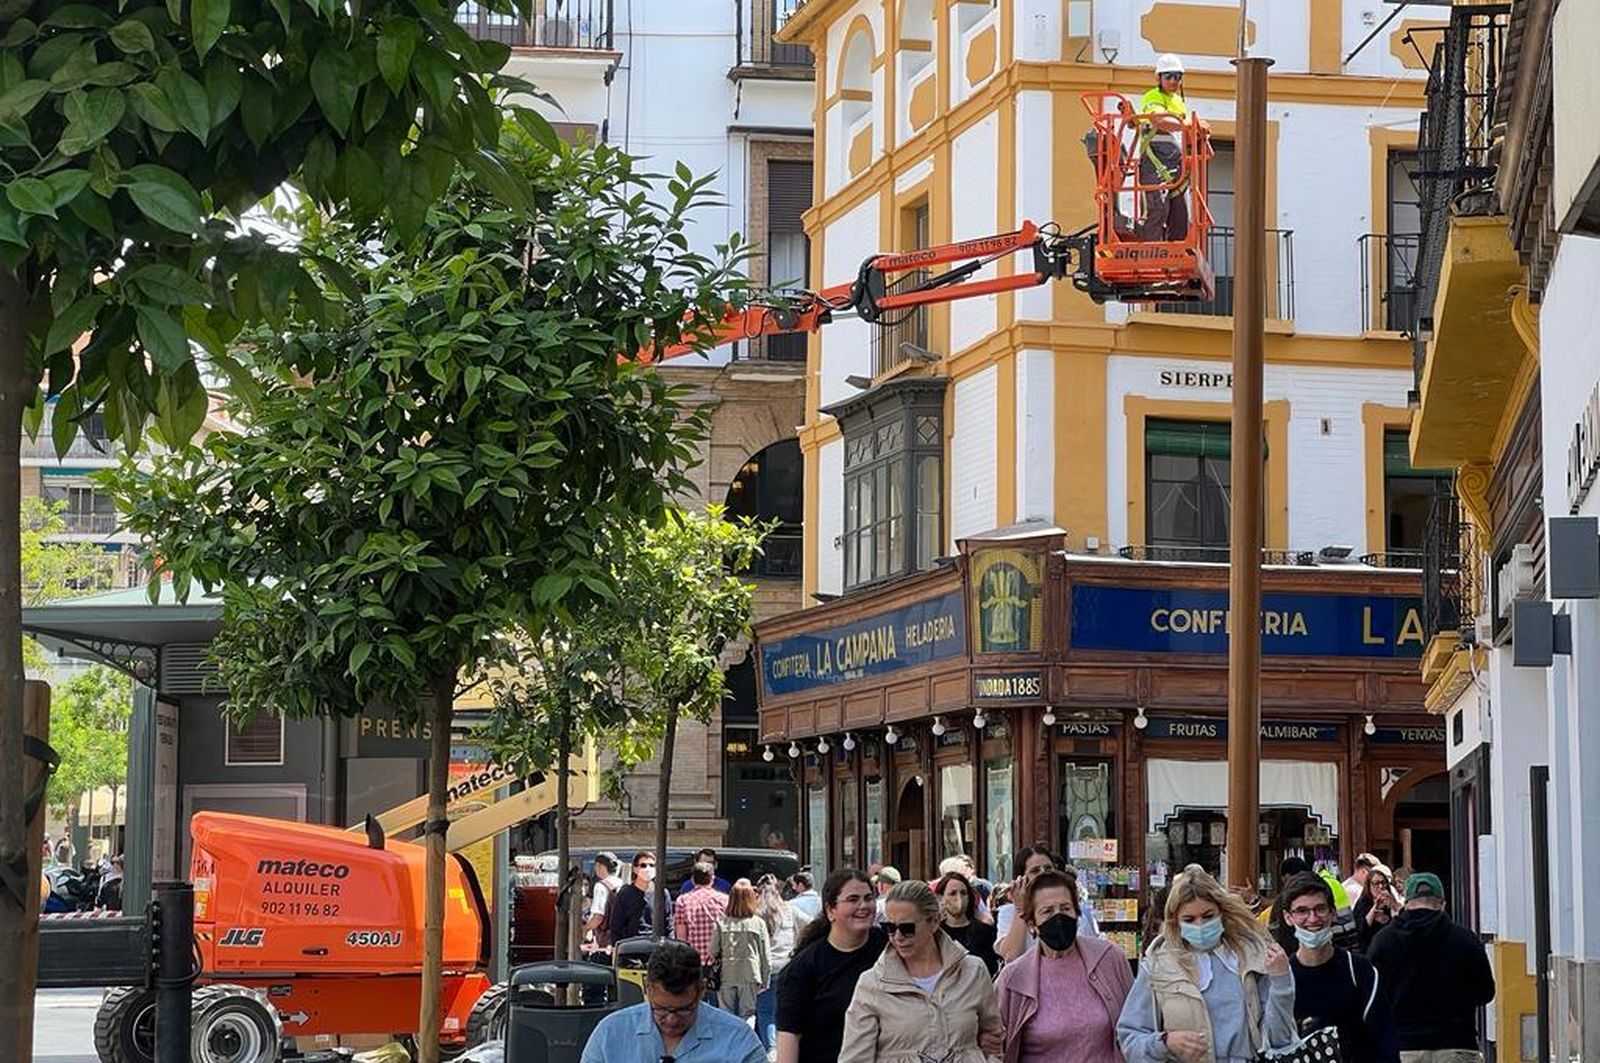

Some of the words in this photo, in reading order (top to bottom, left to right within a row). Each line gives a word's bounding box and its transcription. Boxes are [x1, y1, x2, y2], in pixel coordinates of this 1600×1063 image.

[889, 250, 936, 266] mateco
[1151, 608, 1308, 636] CONFIRIA
[816, 641, 832, 676] LA
[836, 624, 897, 672] CAMPANA
[1012, 677, 1040, 695] 1885
[1062, 723, 1109, 735] PASTAS
[1168, 723, 1217, 737] FRUTAS
[1400, 728, 1445, 741] YEMAS
[257, 858, 349, 879] mateco
[262, 881, 340, 897] ALQUILER
[261, 902, 285, 915] 902
[290, 903, 300, 915] 11
[304, 903, 320, 917] 96
[322, 904, 340, 917] 82
[220, 928, 263, 946] JLG
[346, 930, 402, 946] 450AJ
